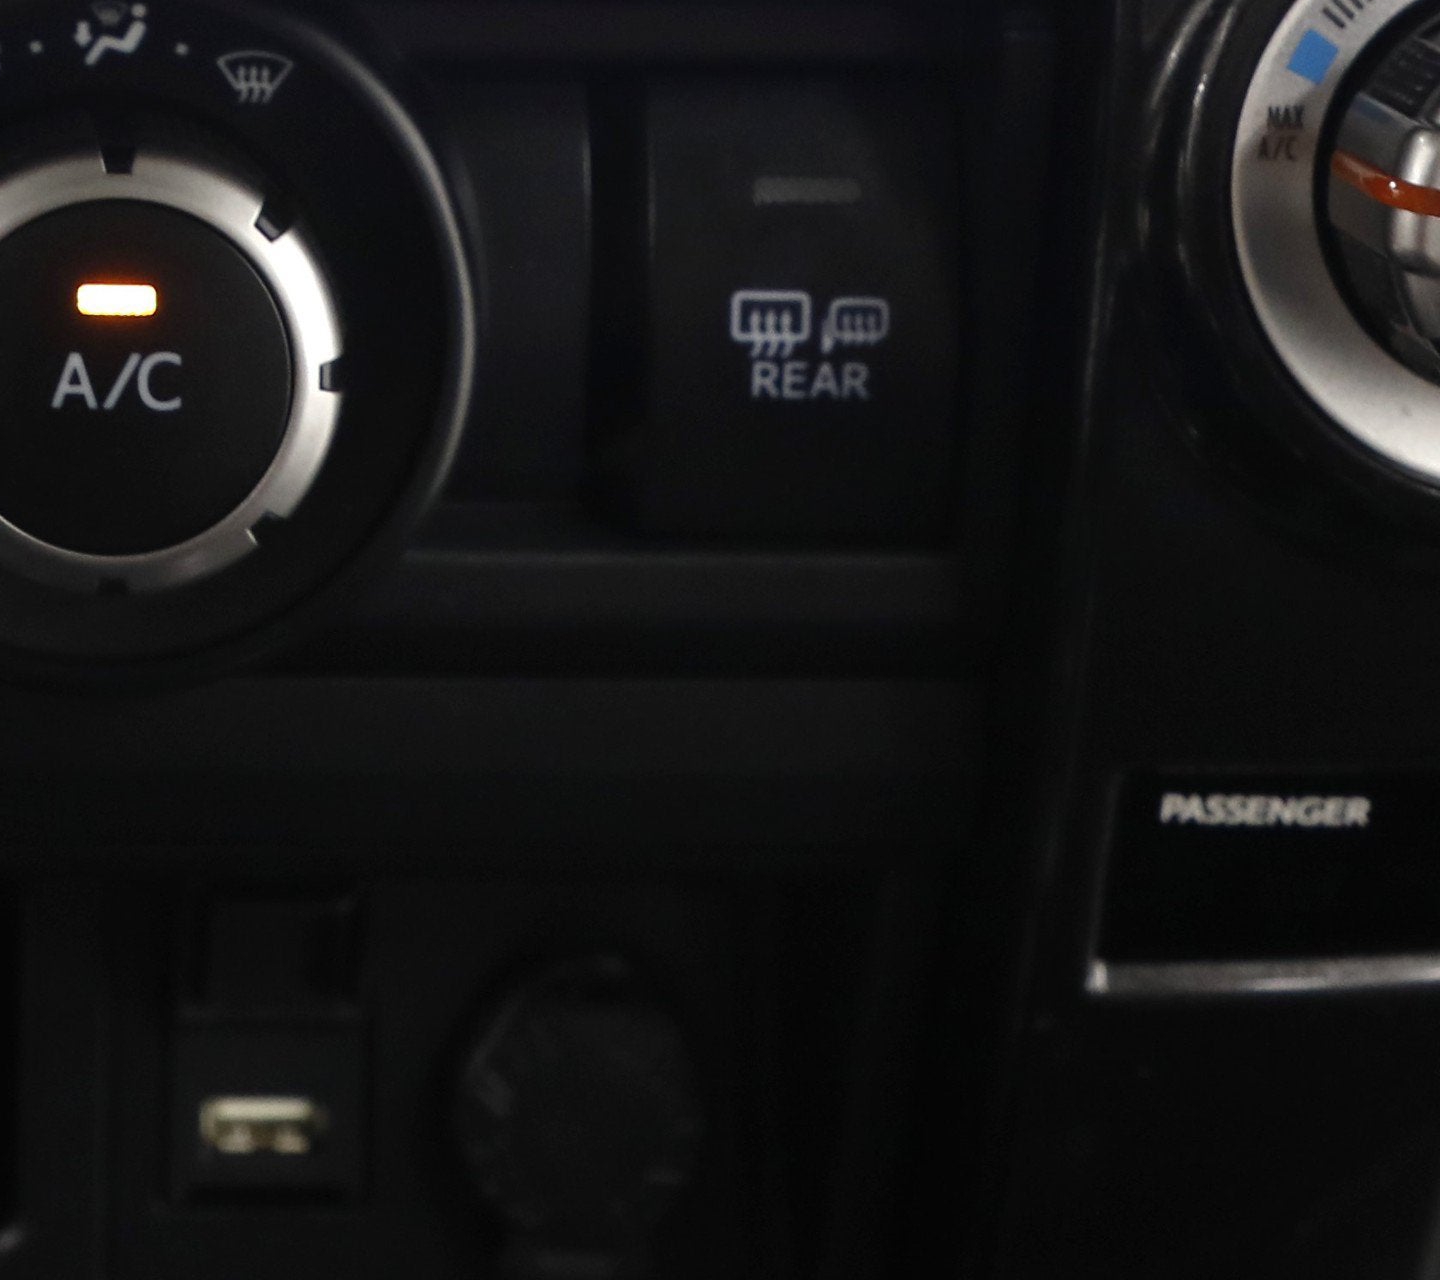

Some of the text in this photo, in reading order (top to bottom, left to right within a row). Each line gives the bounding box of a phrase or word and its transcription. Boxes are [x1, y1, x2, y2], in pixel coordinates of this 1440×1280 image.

[50, 351, 183, 413] A/C
[750, 359, 870, 400] REAR
[1159, 793, 1372, 828] PASSENGER
